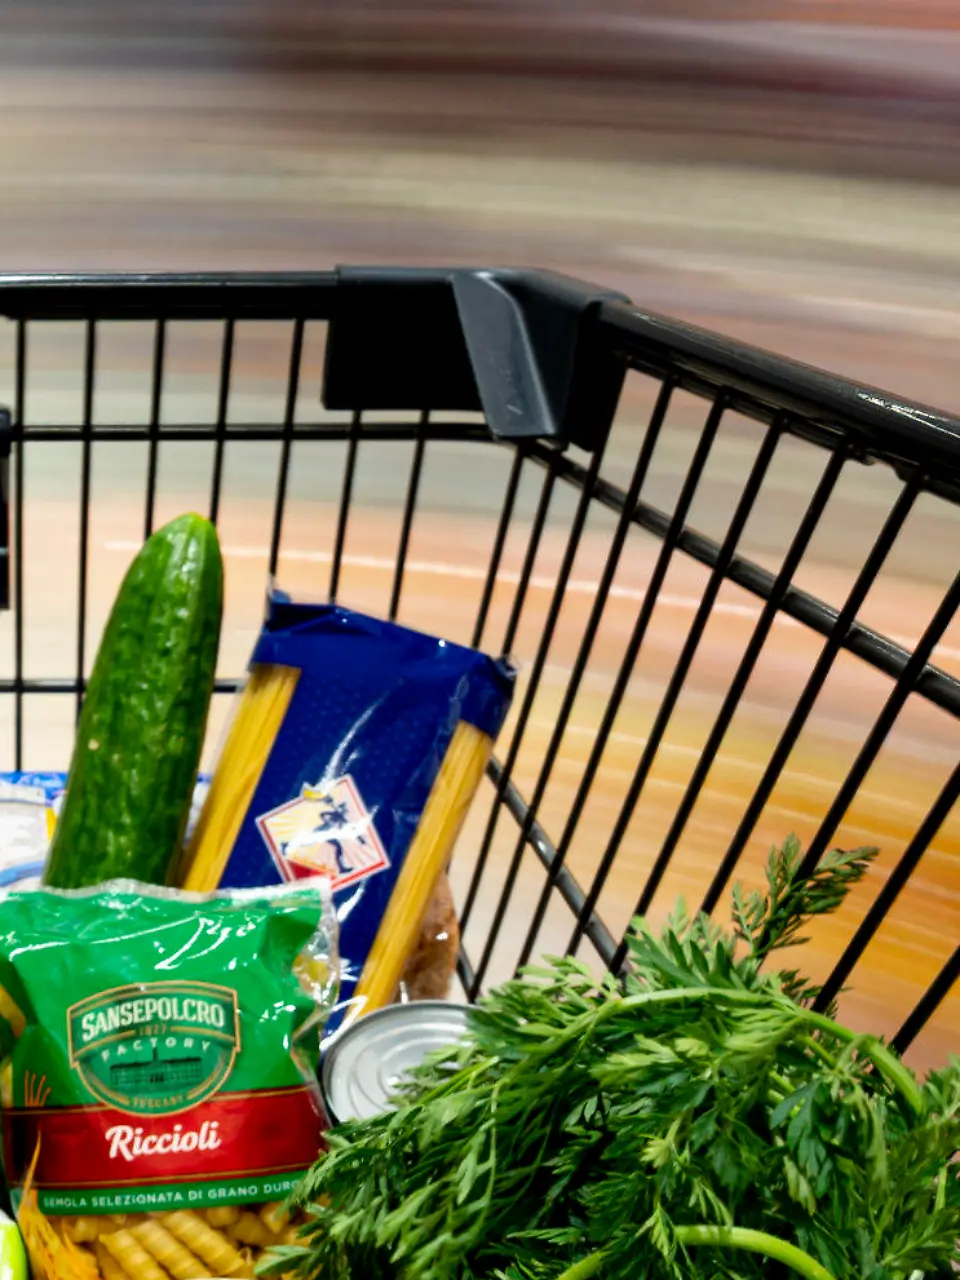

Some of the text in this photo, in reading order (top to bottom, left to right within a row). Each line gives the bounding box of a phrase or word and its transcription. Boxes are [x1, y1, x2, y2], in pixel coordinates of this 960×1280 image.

[82, 998, 225, 1042] SANSEPOLCRO
[101, 1037, 211, 1062] FACTORY
[105, 1121, 222, 1162] Riccioli
[91, 1191, 183, 1208] SELEZIONATA
[188, 1189, 203, 1200] DI
[207, 1185, 258, 1199] GRANO
